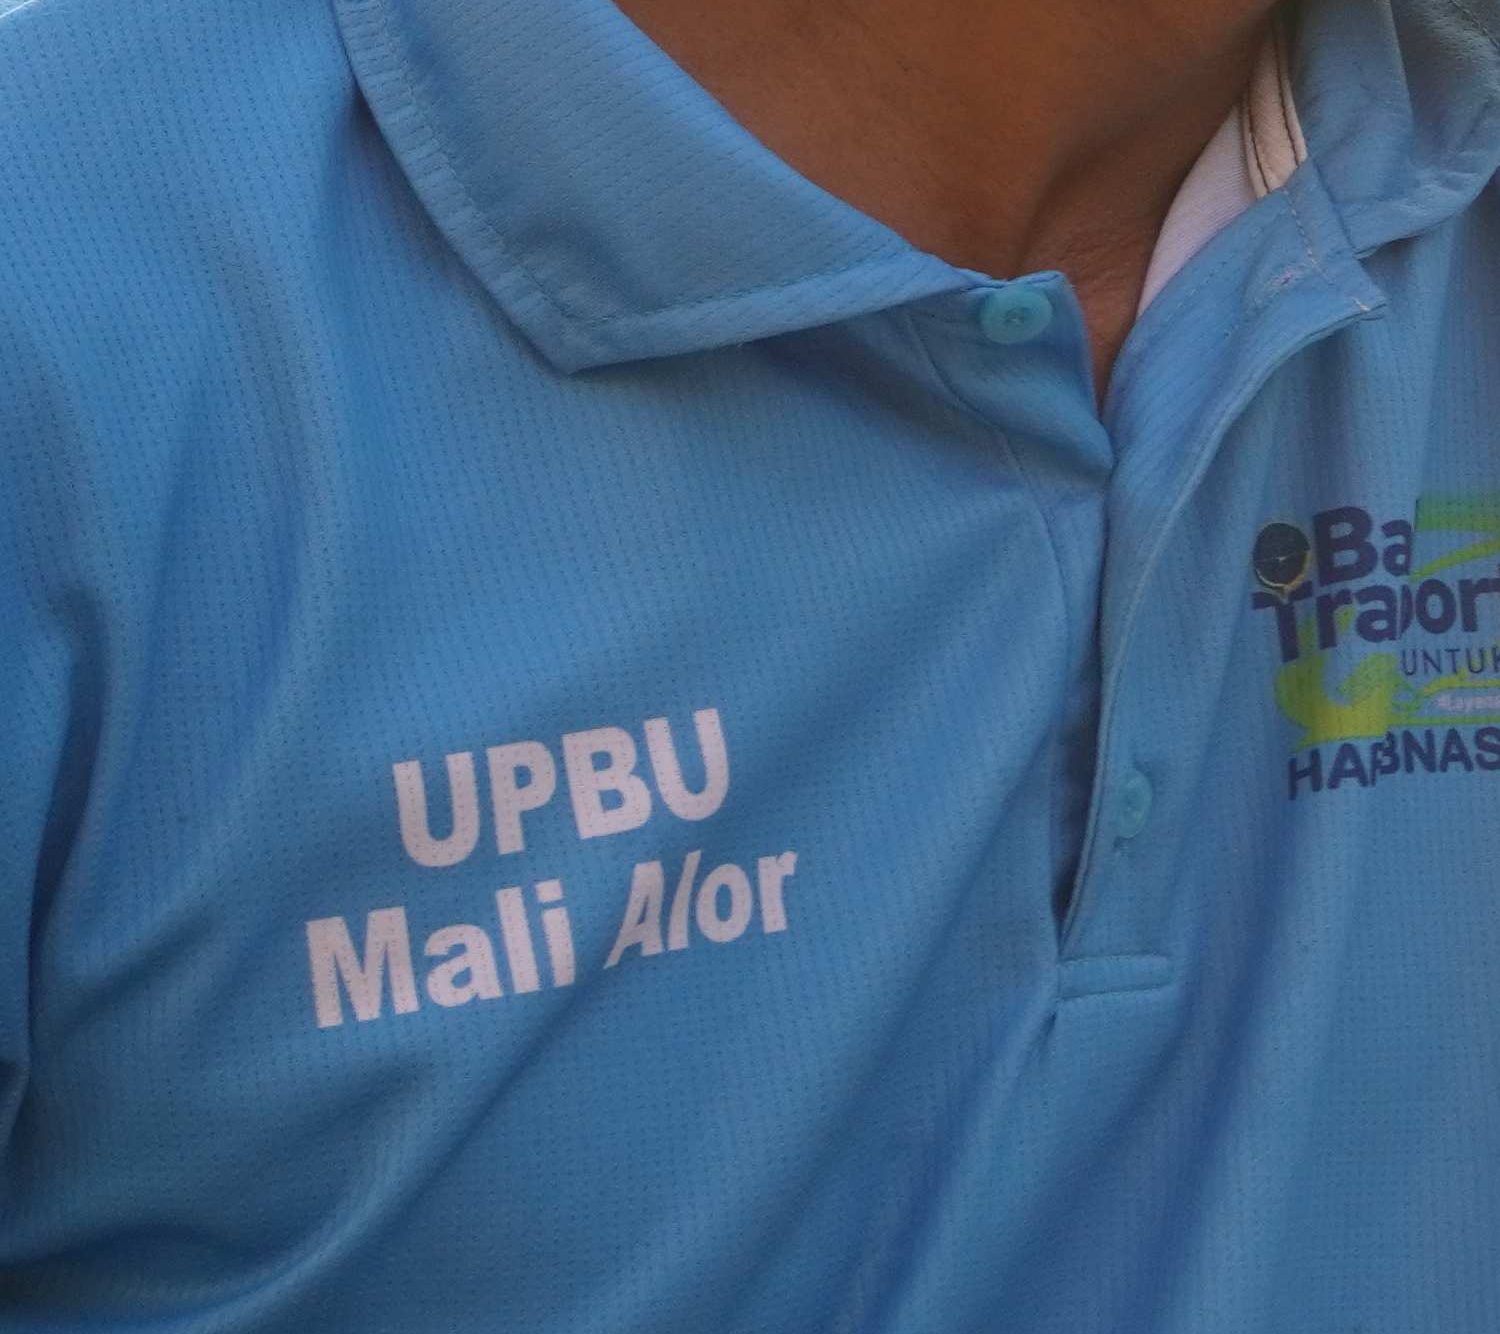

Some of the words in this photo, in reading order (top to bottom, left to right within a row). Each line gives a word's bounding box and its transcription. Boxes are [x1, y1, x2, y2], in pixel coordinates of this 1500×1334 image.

[393, 708, 730, 867] UPBU
[305, 878, 576, 1028] Mali
[603, 850, 798, 969] Alor
